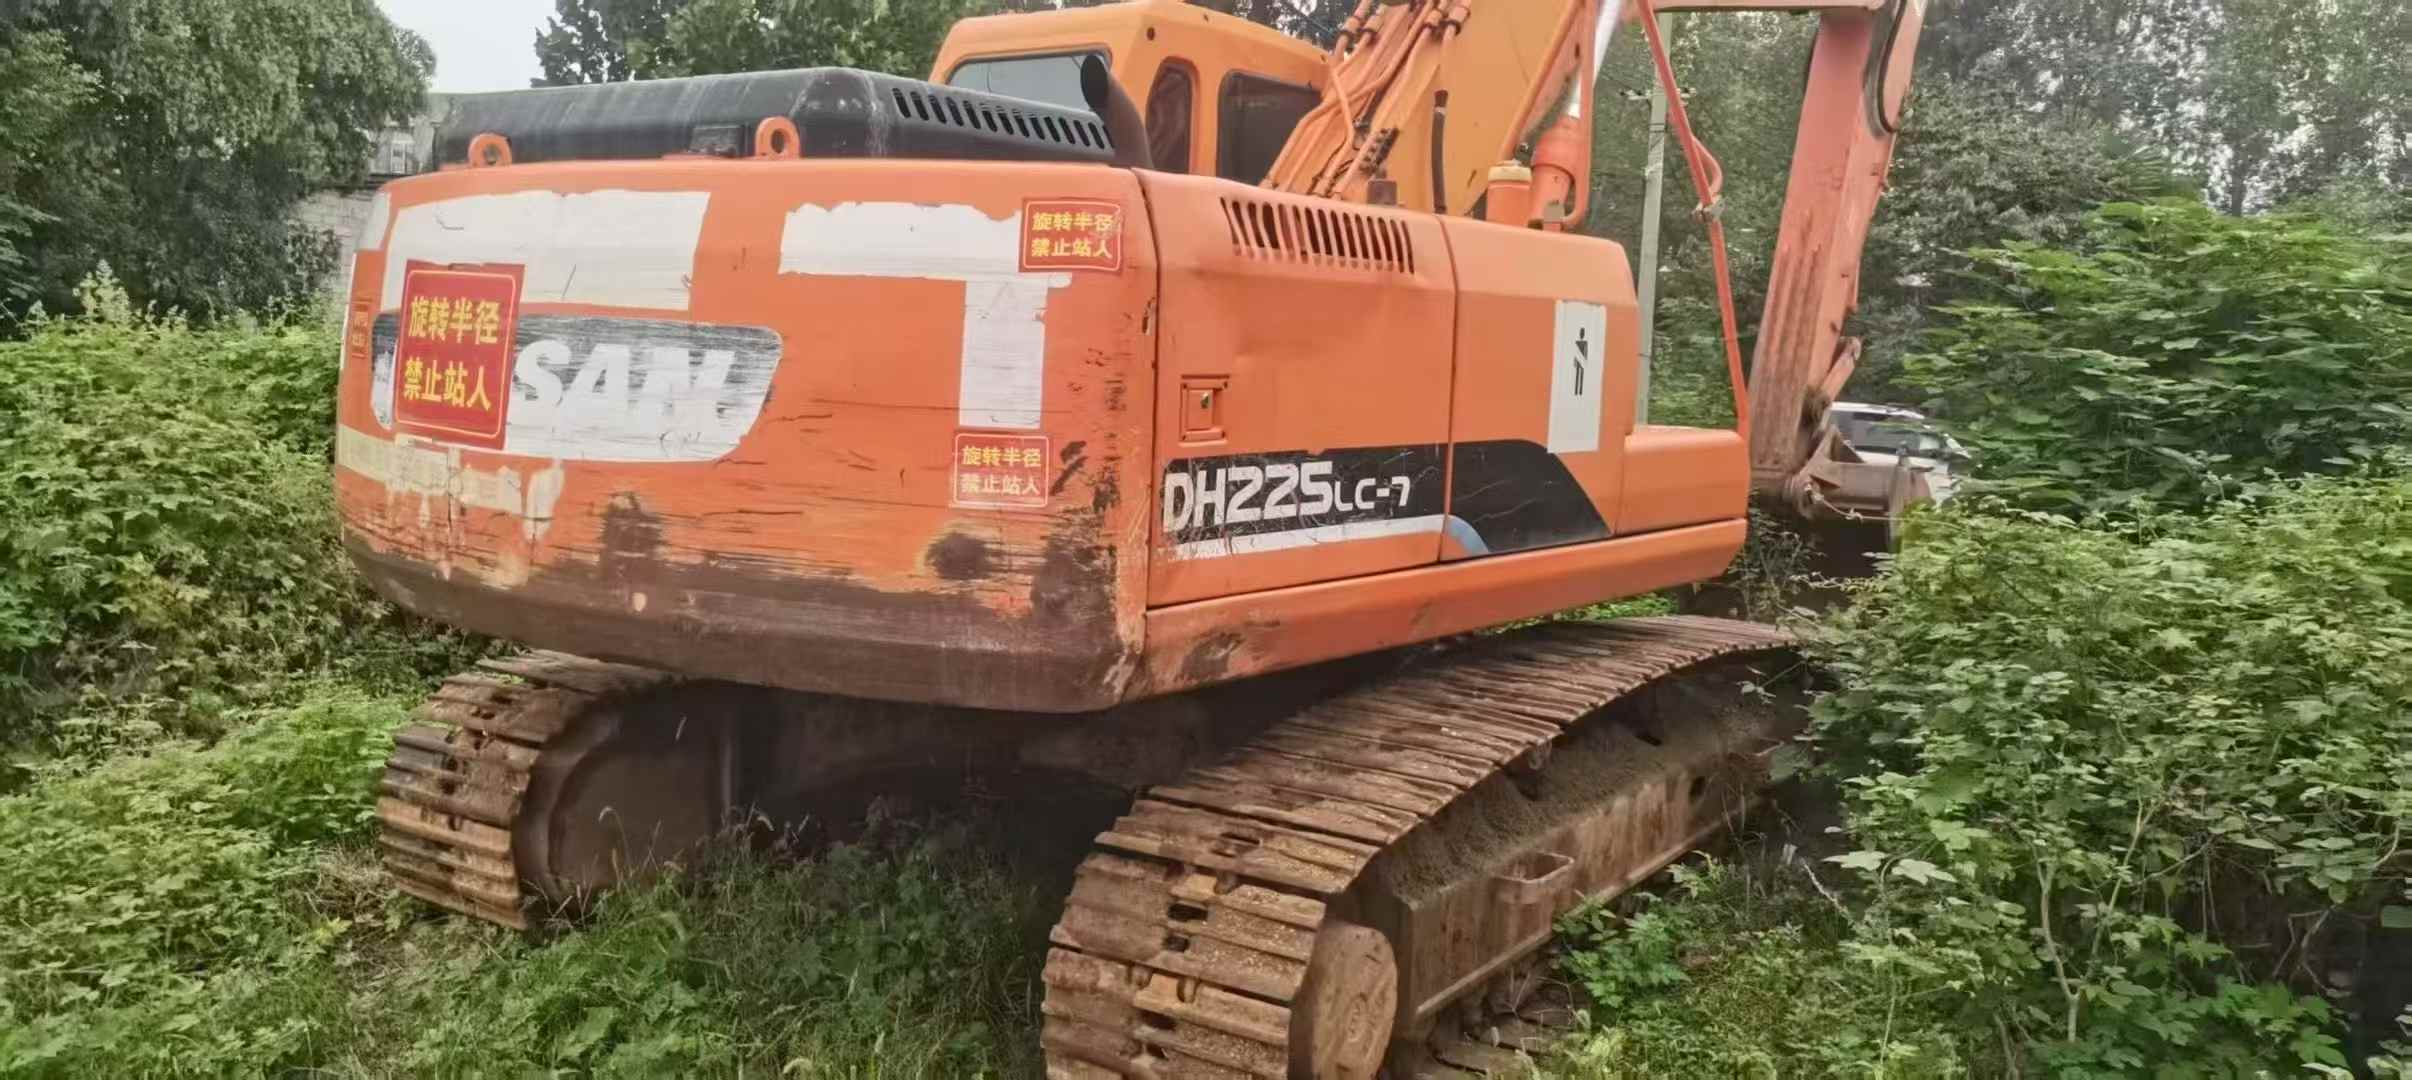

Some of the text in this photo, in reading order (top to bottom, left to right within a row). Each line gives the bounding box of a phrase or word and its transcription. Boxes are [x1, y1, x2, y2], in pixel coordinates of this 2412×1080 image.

[1031, 212, 1113, 232] 旋转半径
[1031, 237, 1113, 259] 禁止站人
[408, 295, 500, 345] 旋转半径
[403, 356, 492, 411] 禁止站人
[961, 445, 1042, 467] 旋转半径
[960, 473, 1040, 496] 禁止站人
